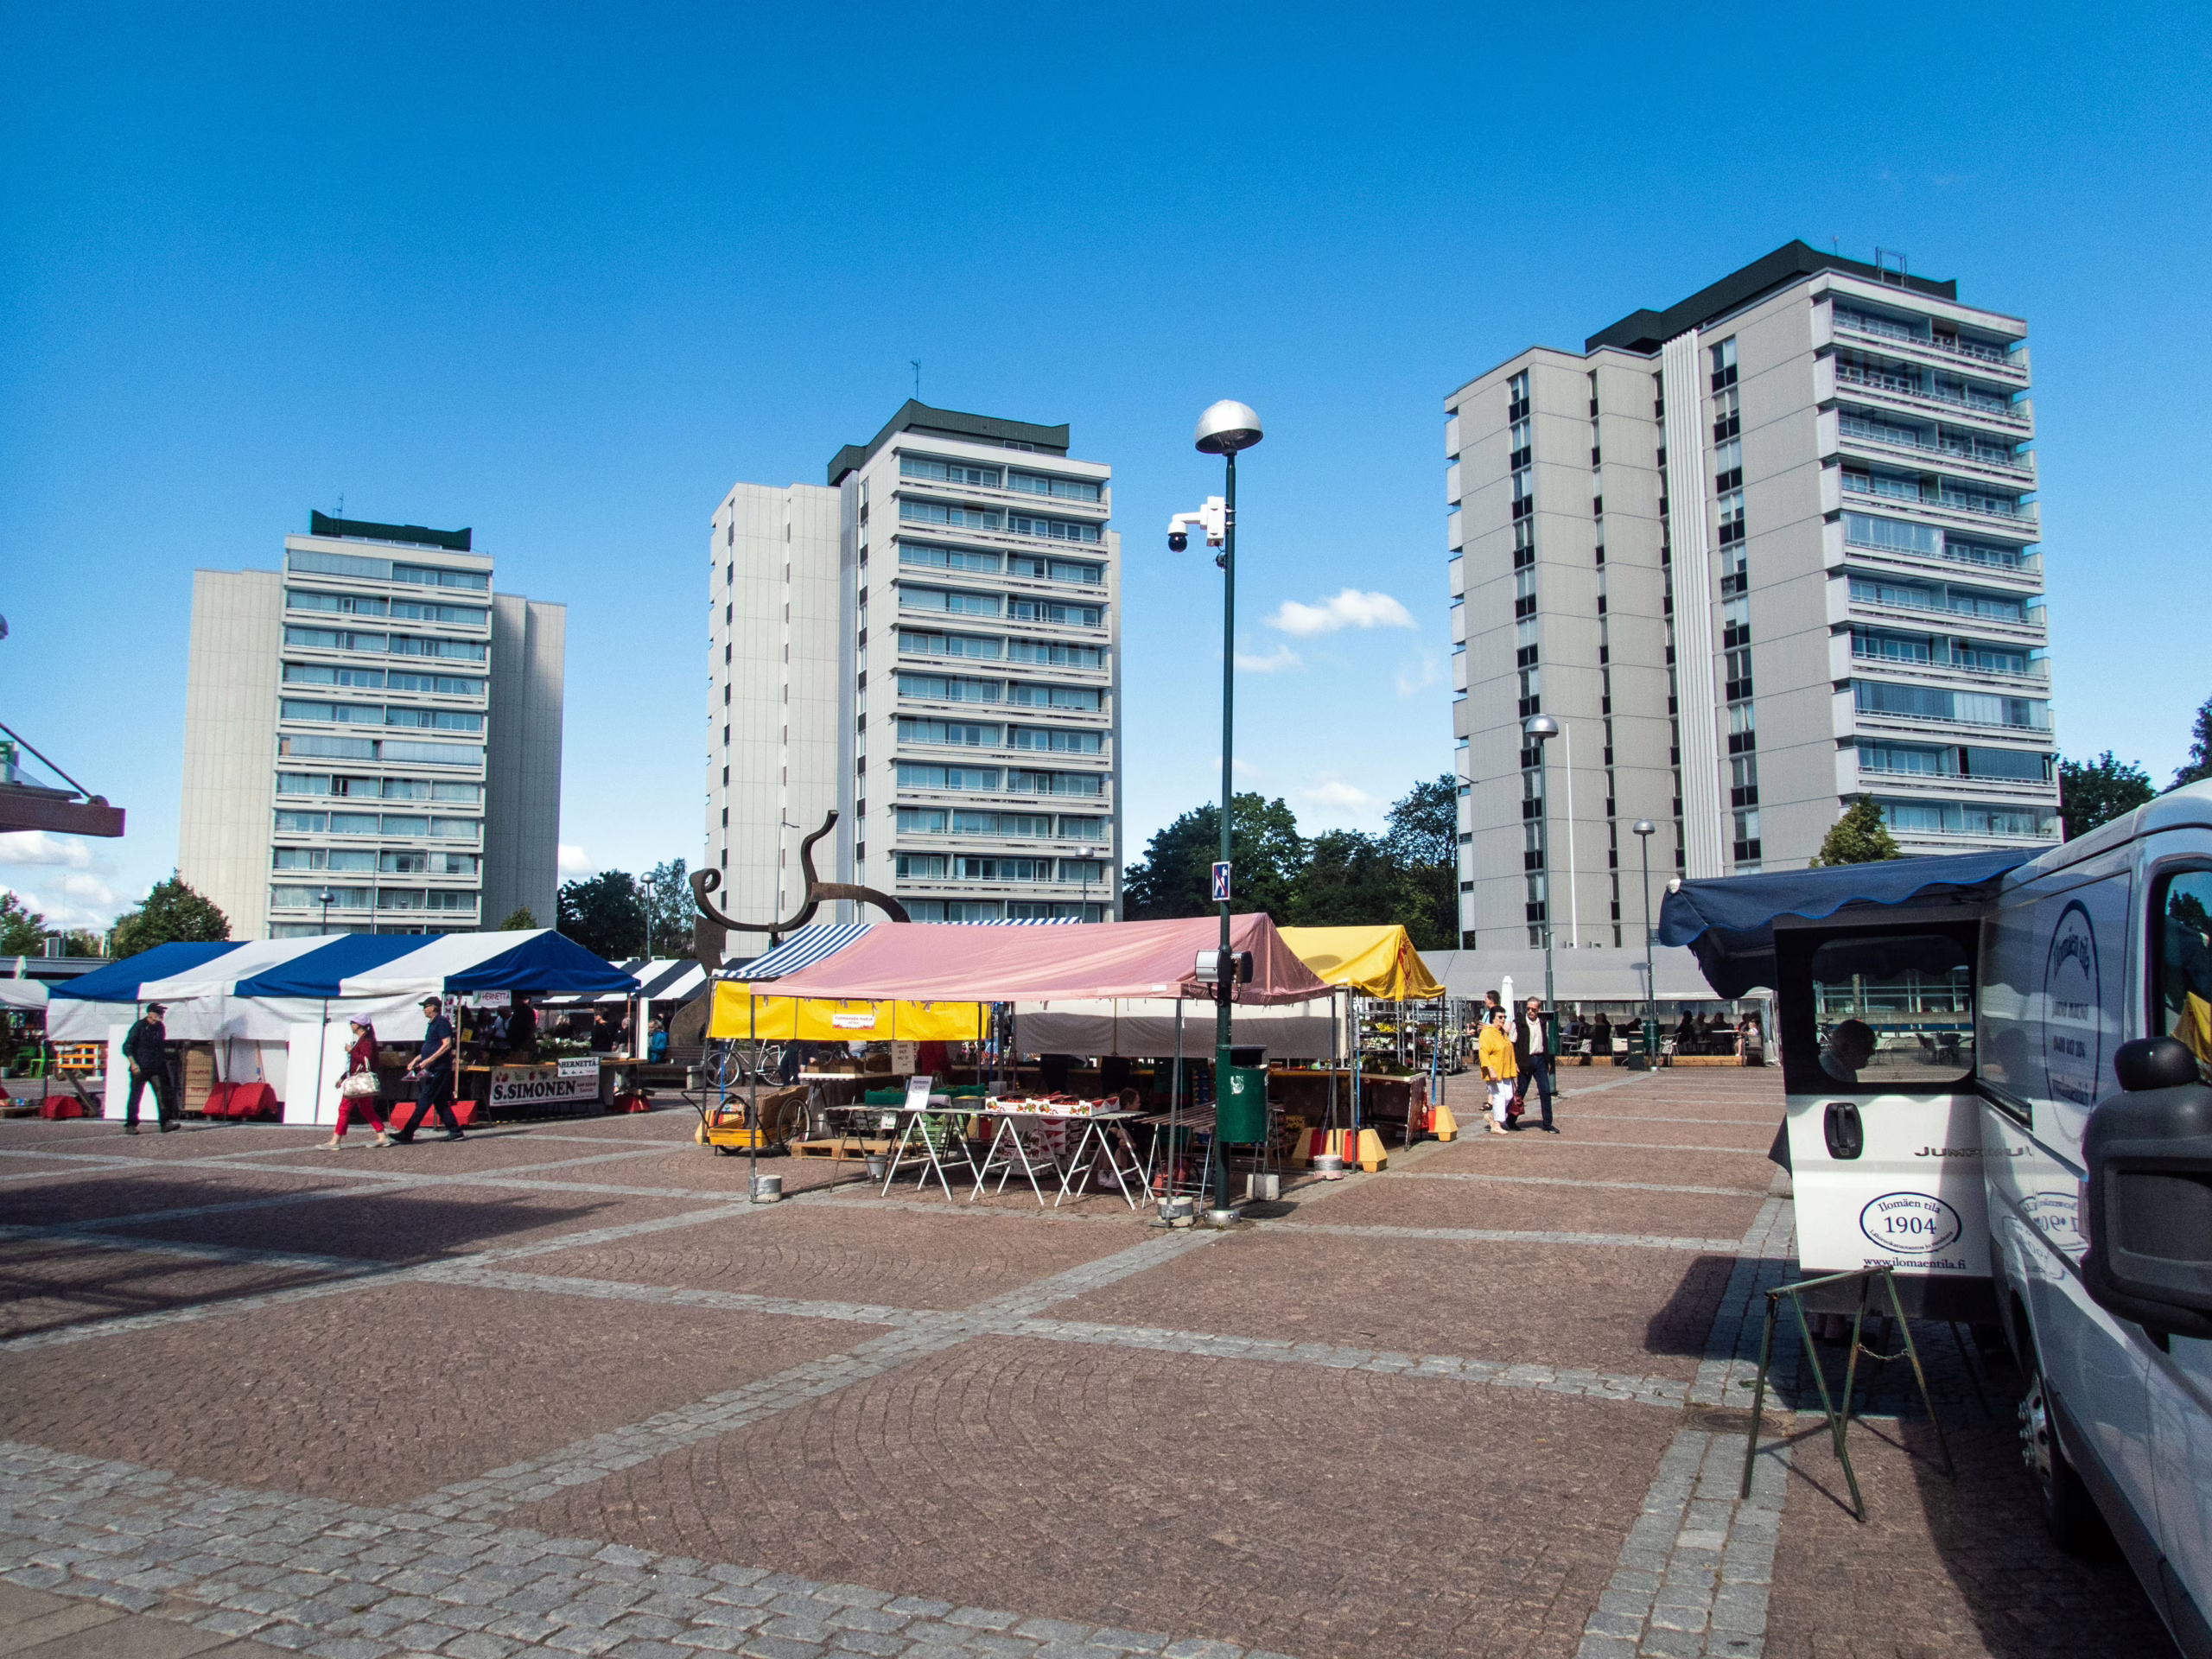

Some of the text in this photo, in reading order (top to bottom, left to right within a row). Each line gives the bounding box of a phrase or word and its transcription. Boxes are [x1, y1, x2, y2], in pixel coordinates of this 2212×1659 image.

[481, 990, 511, 1001] HERNETTÄ
[561, 1058, 597, 1068] HERNETTÄ
[493, 1080, 576, 1100] S.SIMONEN
[1878, 1198, 1942, 1215] Ilomäen tila
[1884, 1216, 1937, 1235] 1904
[1863, 1256, 1966, 1269] www.ilomaentila.fi
